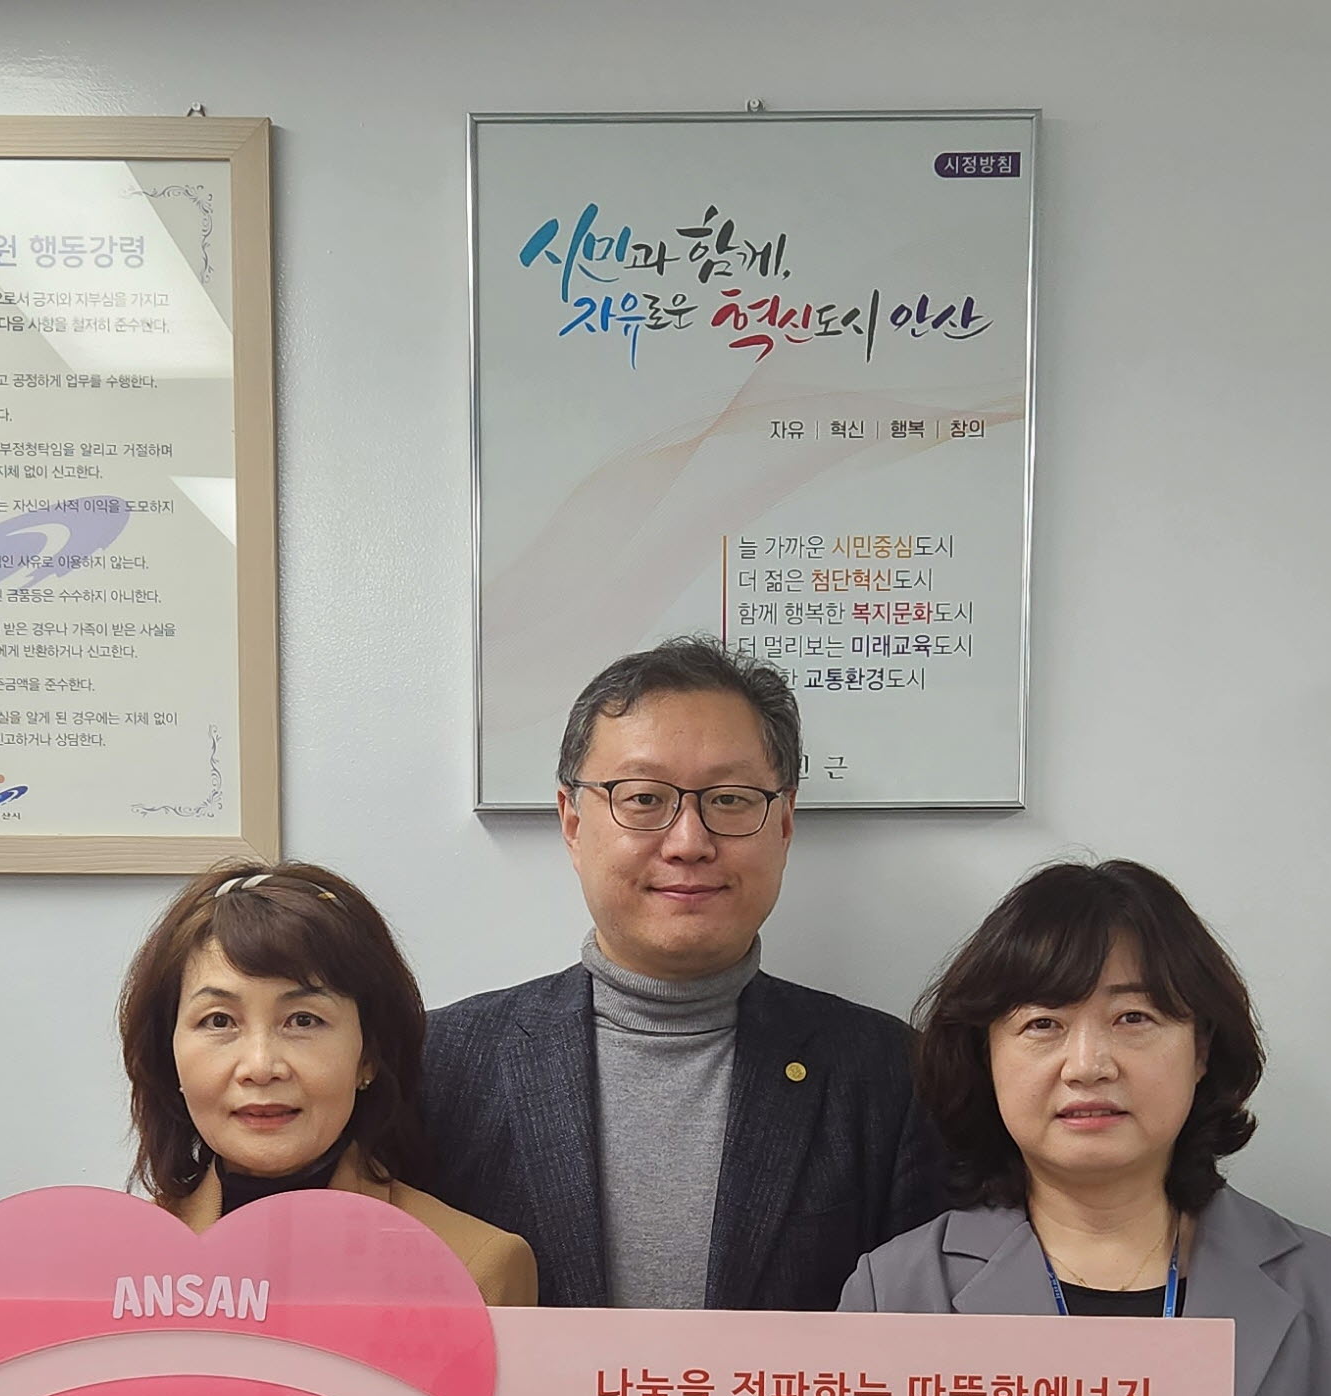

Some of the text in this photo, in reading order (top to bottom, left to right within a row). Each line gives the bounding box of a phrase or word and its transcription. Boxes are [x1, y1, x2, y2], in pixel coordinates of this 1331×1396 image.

[943, 156, 1012, 174] 시정방침
[29, 234, 145, 269] 행동강령
[519, 202, 791, 303] 시민과 함께,
[33, 291, 71, 307] 긍지와
[75, 292, 127, 308] 자부심을
[131, 293, 170, 308] 가지고
[558, 288, 994, 370] 자유로운 혁신도시 안산
[12, 373, 61, 388] 공정하게
[66, 373, 102, 388] 업무를
[106, 374, 158, 389] 수행한다.
[770, 420, 985, 440] 자유 혁신 행복 창의
[0, 442, 75, 457] 부정청탁임을
[80, 442, 118, 457] 알리고
[123, 443, 173, 458] 거절하며
[23, 465, 48, 479] 없이
[51, 465, 103, 480] 신고한다.
[13, 498, 50, 513] 자신의
[54, 499, 79, 514] 사적
[84, 499, 121, 514] 이익을
[125, 500, 174, 515] 도모하지
[738, 534, 954, 561] 늘 가까운 시민중심도시
[17, 555, 54, 570] 사유로
[58, 555, 106, 570] 이용하지
[110, 555, 149, 571] 않는다.
[738, 568, 932, 593] 더 젊은 첨단혁신도시
[6, 588, 54, 603] 금품등은
[59, 588, 107, 604] 수수하지
[110, 589, 162, 604] 아니한다.
[738, 601, 973, 626] 함께 행복한 복지문화도시
[3, 622, 28, 636] 받은
[31, 622, 68, 637] 경우나
[72, 622, 108, 637] 가족이
[111, 622, 137, 637] 받은
[140, 622, 177, 638] 사실을
[23, 644, 83, 659] 반환하거나
[87, 644, 138, 659] 신고한다.
[738, 634, 973, 659] 더 멀리보는 미래교육도시
[44, 677, 96, 692] 준수한다.
[803, 667, 925, 691] 교통환경도시
[26, 711, 50, 726] 알게
[55, 711, 67, 726] 된
[72, 711, 120, 726] 경우에는
[124, 711, 149, 726] 지체
[153, 712, 178, 727] 없이
[54, 733, 106, 748] 상담한다.
[112, 1273, 270, 1323] ANSAN
